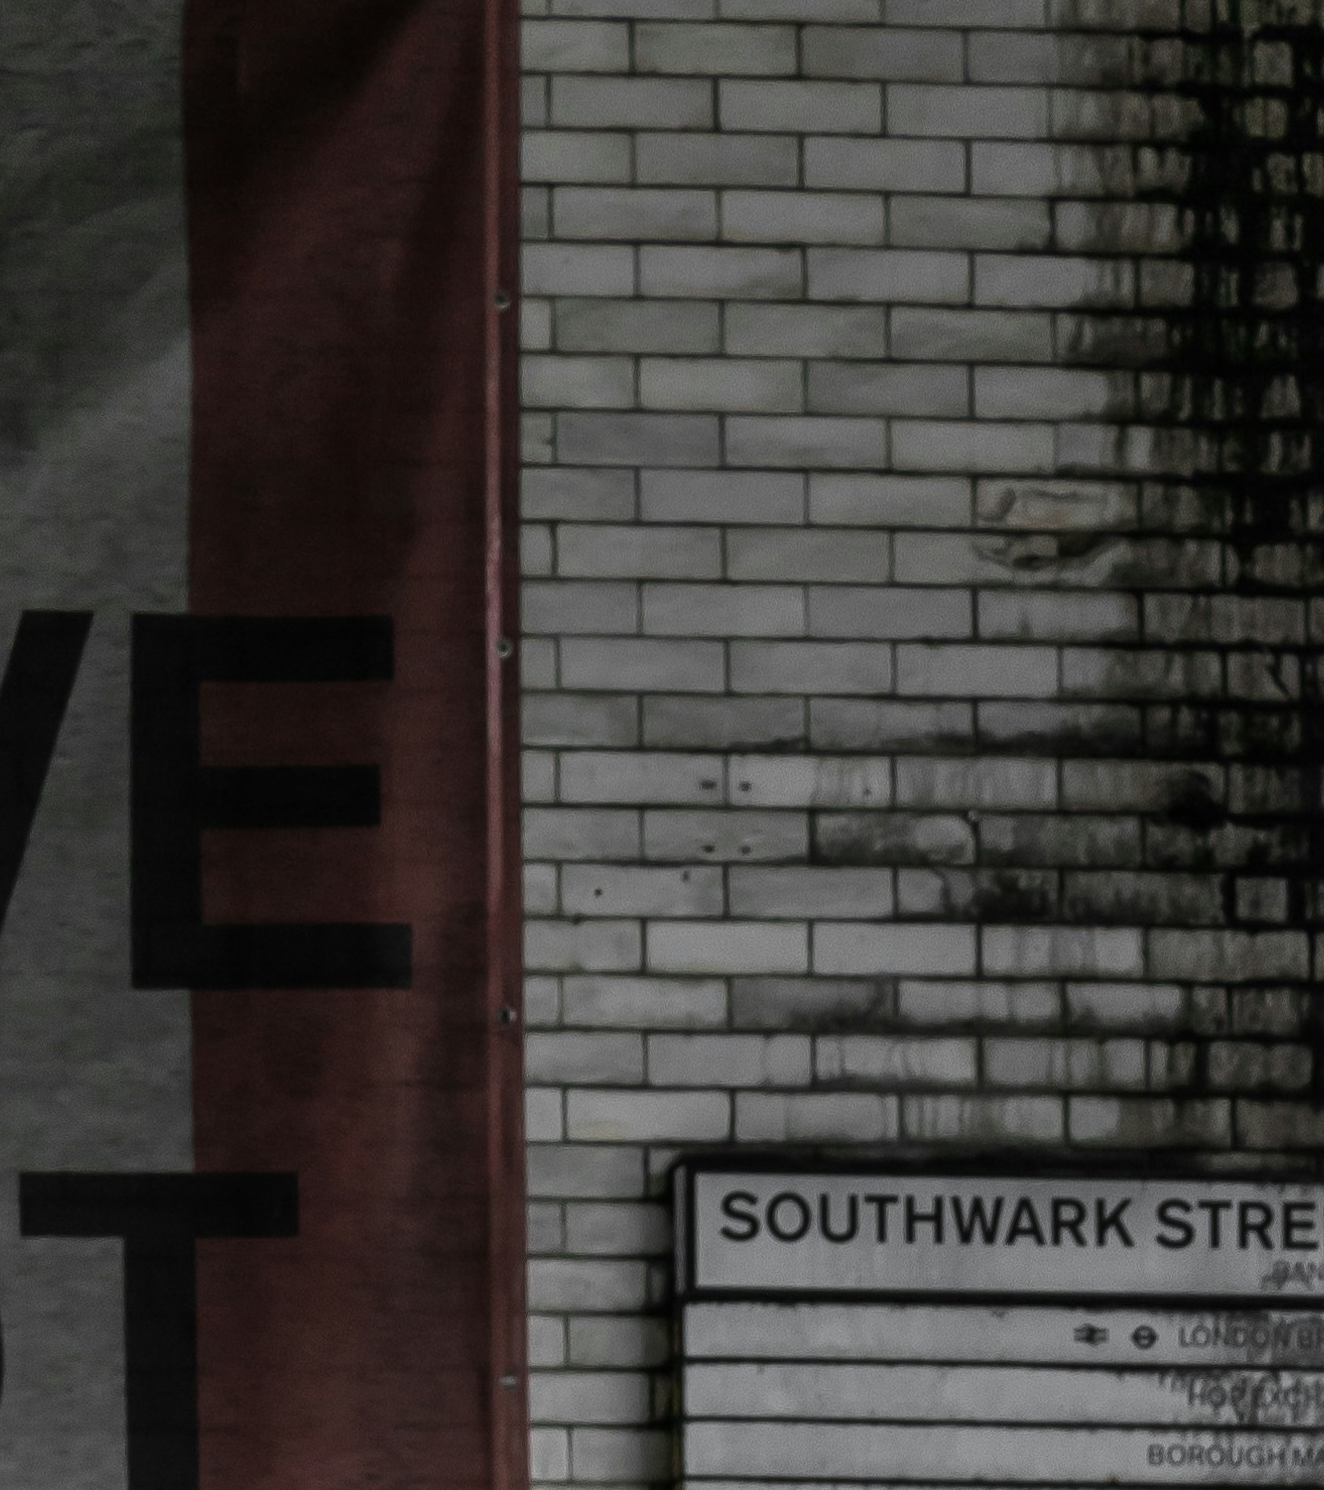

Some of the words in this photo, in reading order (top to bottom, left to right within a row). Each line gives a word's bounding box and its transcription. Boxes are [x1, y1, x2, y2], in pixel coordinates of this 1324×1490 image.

[720, 1190, 1134, 1248] SOUTHWARK
[1178, 1324, 1287, 1351] LONDON
[1146, 1443, 1284, 1468] BOROUGH
